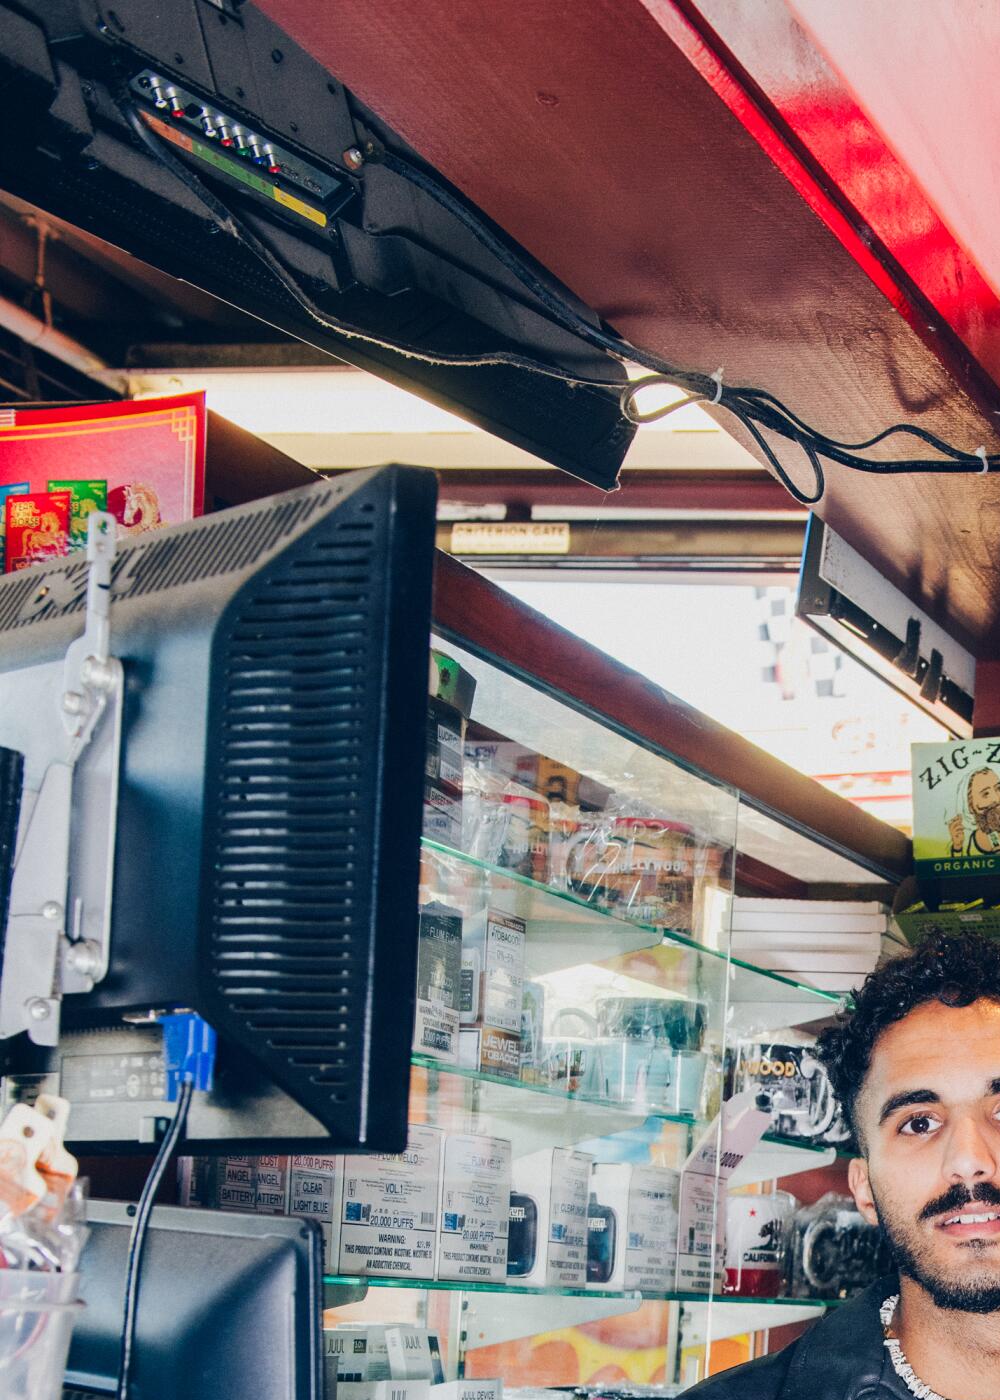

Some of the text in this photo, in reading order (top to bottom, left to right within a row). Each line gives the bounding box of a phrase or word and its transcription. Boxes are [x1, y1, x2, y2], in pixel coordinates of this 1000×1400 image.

[456, 525, 568, 539] CRITERION GATE
[483, 1035, 520, 1054] JEWEL
[483, 1047, 519, 1065] TOBACCO
[293, 1155, 335, 1171] 20,000 PUFFS
[226, 1169, 250, 1182] ANGEL
[256, 1173, 279, 1187] ANGEL
[221, 1188, 255, 1202] BATTERY
[302, 1181, 324, 1195] CLEAR
[293, 1199, 329, 1214] LIGHT BLUE
[369, 1215, 414, 1229] 20,000 PUFFS
[378, 1233, 407, 1245] WARNING:
[328, 1338, 345, 1355] JUUL
[405, 1335, 422, 1350] JUUL
[461, 1390, 495, 1400] JUUL DEVICE
